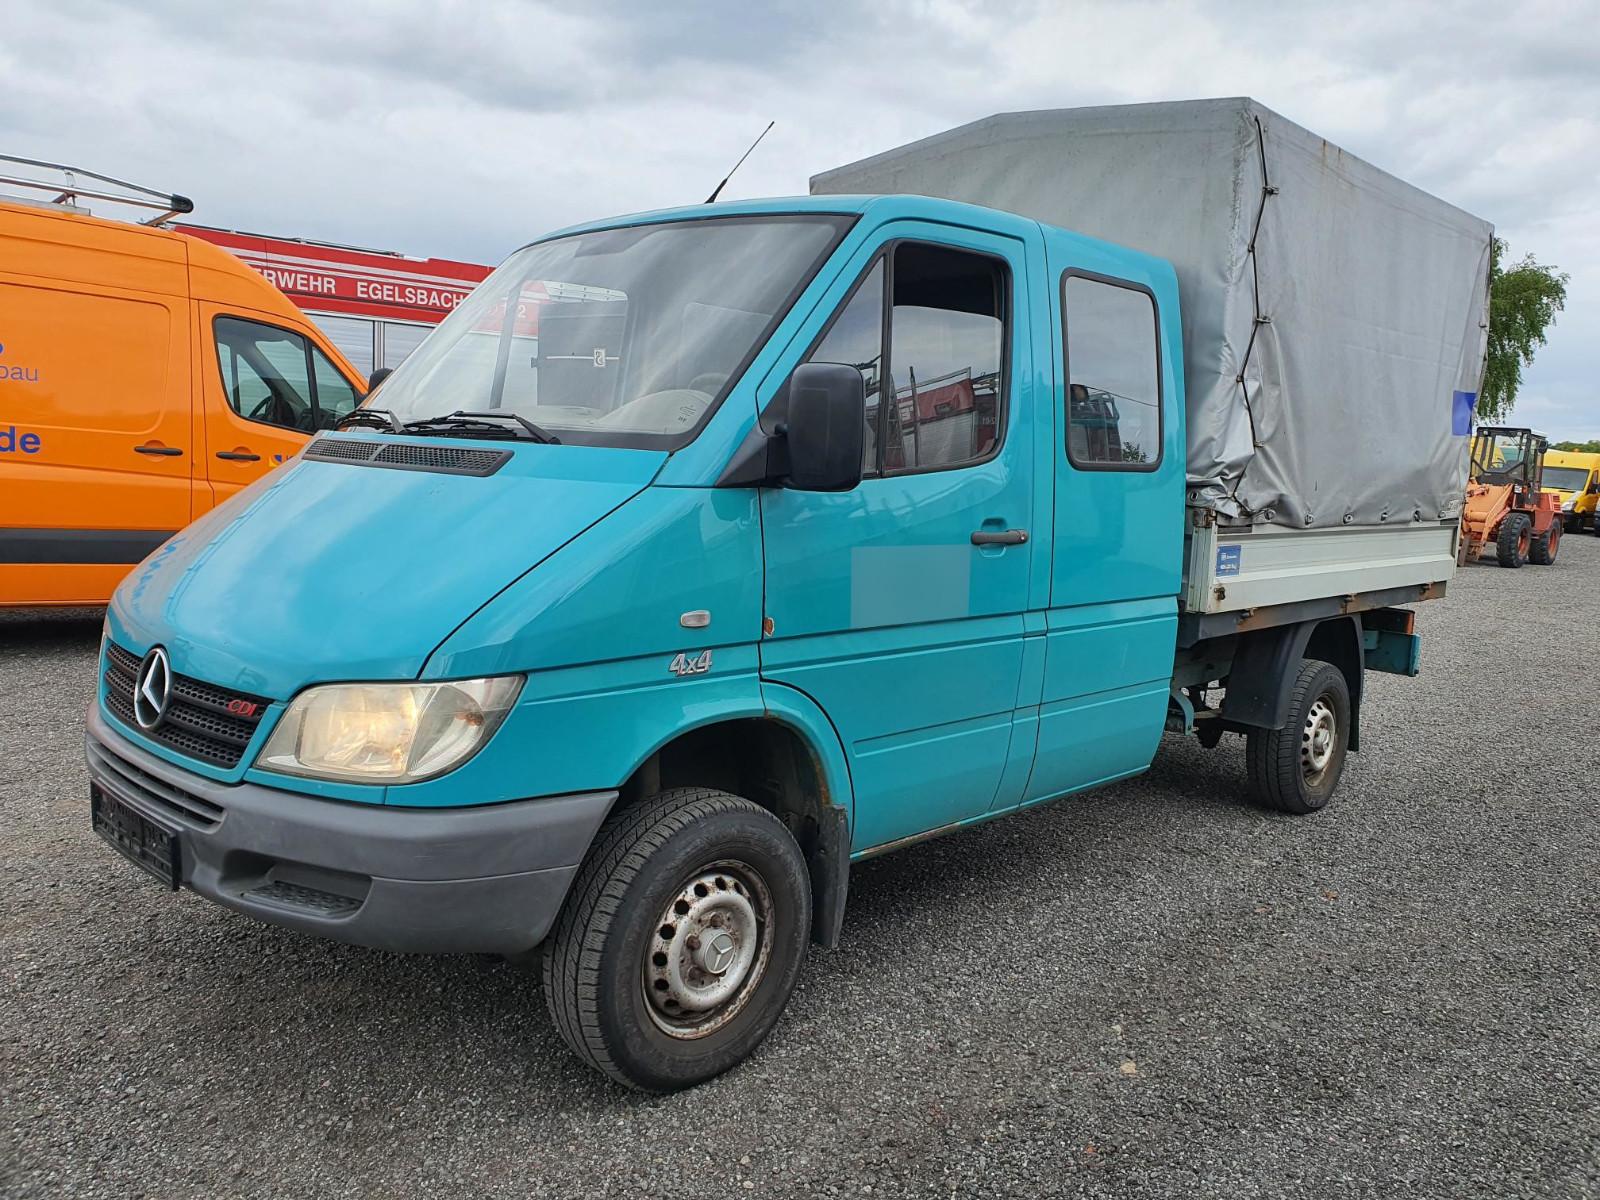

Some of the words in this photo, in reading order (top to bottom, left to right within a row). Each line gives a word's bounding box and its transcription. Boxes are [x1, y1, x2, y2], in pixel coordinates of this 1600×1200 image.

[258, 268, 336, 294] RWEHR
[356, 281, 464, 309] EGELSBACH
[669, 649, 713, 676] 4x4
[228, 699, 258, 717] CDI
